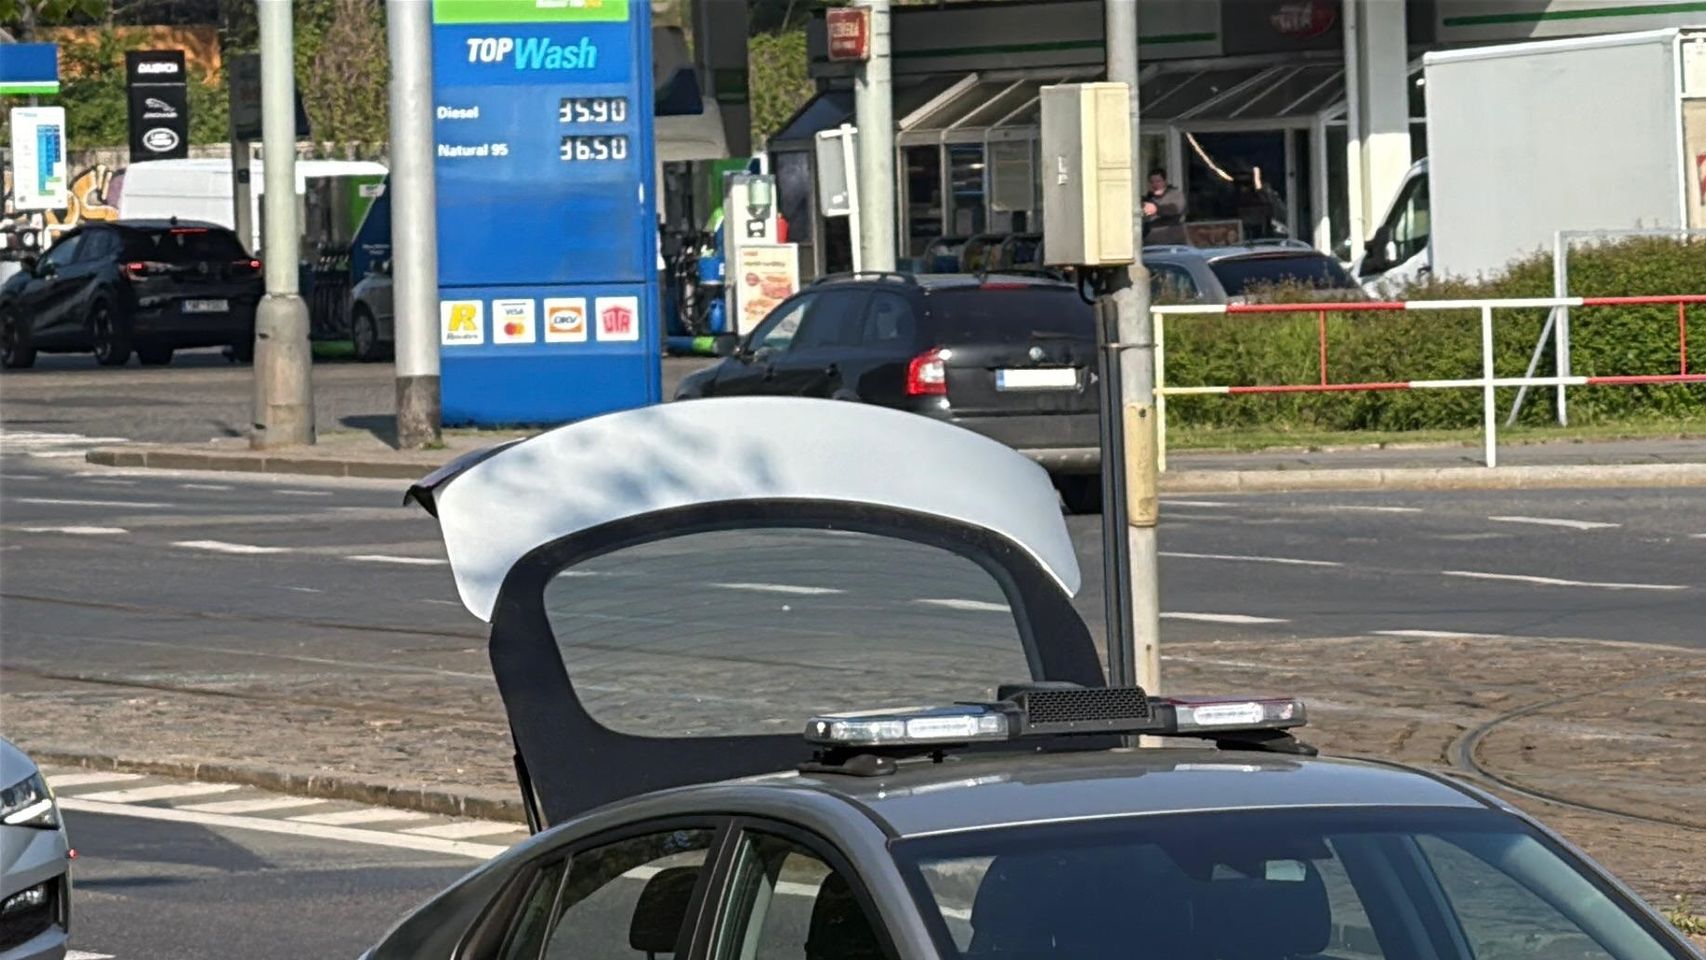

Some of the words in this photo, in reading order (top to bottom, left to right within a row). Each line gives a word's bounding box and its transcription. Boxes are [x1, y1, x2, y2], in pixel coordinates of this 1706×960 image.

[437, 106, 480, 120] Diesel
[559, 99, 627, 123] 35.90
[438, 144, 489, 157] Natural
[491, 143, 509, 156] 95
[560, 137, 627, 161] 36.50
